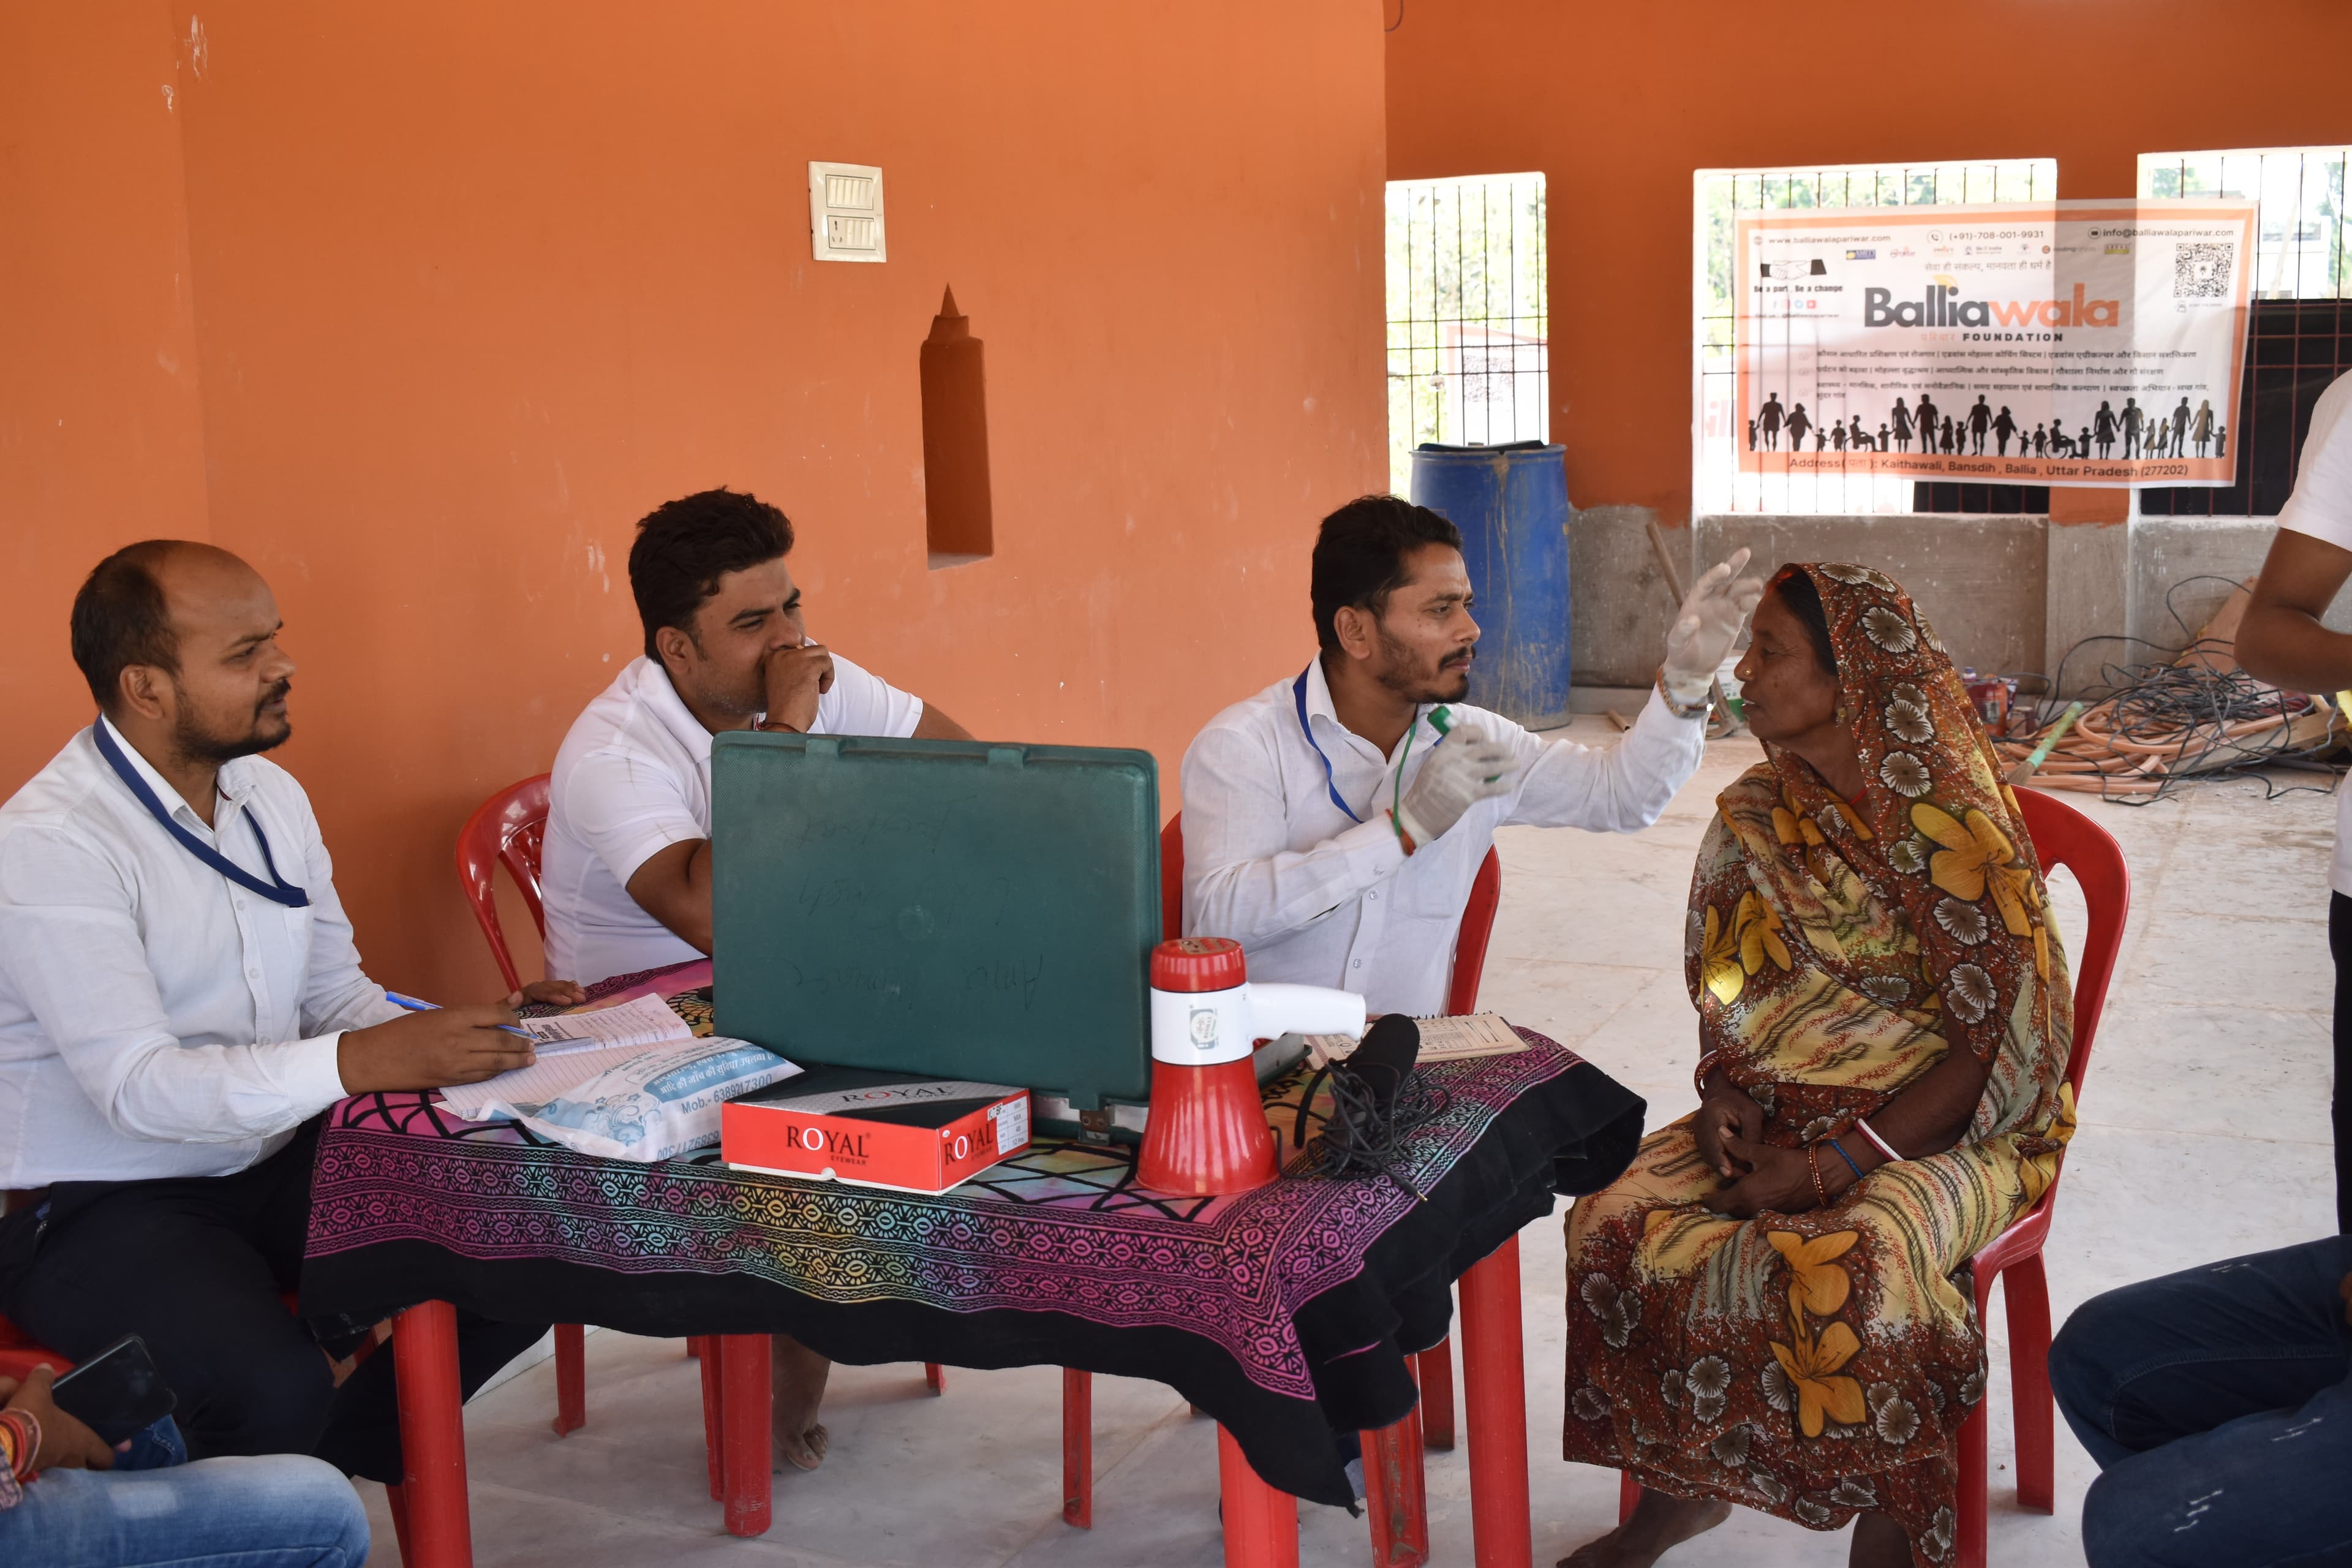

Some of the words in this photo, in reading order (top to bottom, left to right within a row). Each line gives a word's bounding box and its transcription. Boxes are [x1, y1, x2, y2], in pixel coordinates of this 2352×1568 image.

[1769, 235, 1892, 244] www.balliawalapariwar.com
[1950, 230, 2044, 240] (+91)-708-001-9931
[2103, 229, 2234, 238] info@balliawalapariwar.com
[1864, 283, 2120, 327] Balliawala
[1963, 333, 2063, 342] FOUNDATION
[1882, 459, 1945, 472] Kaithawali,
[2046, 465, 2079, 476] Uttar
[2083, 465, 2138, 477] Pradesh
[2141, 465, 2188, 476] (277202)
[713, 1073, 773, 1103] 6389217300
[840, 1087, 955, 1102] ROYAL
[786, 1125, 869, 1158] ROYAL
[944, 1123, 993, 1166] ROYAL
[830, 1155, 867, 1166] EYEWEAR
